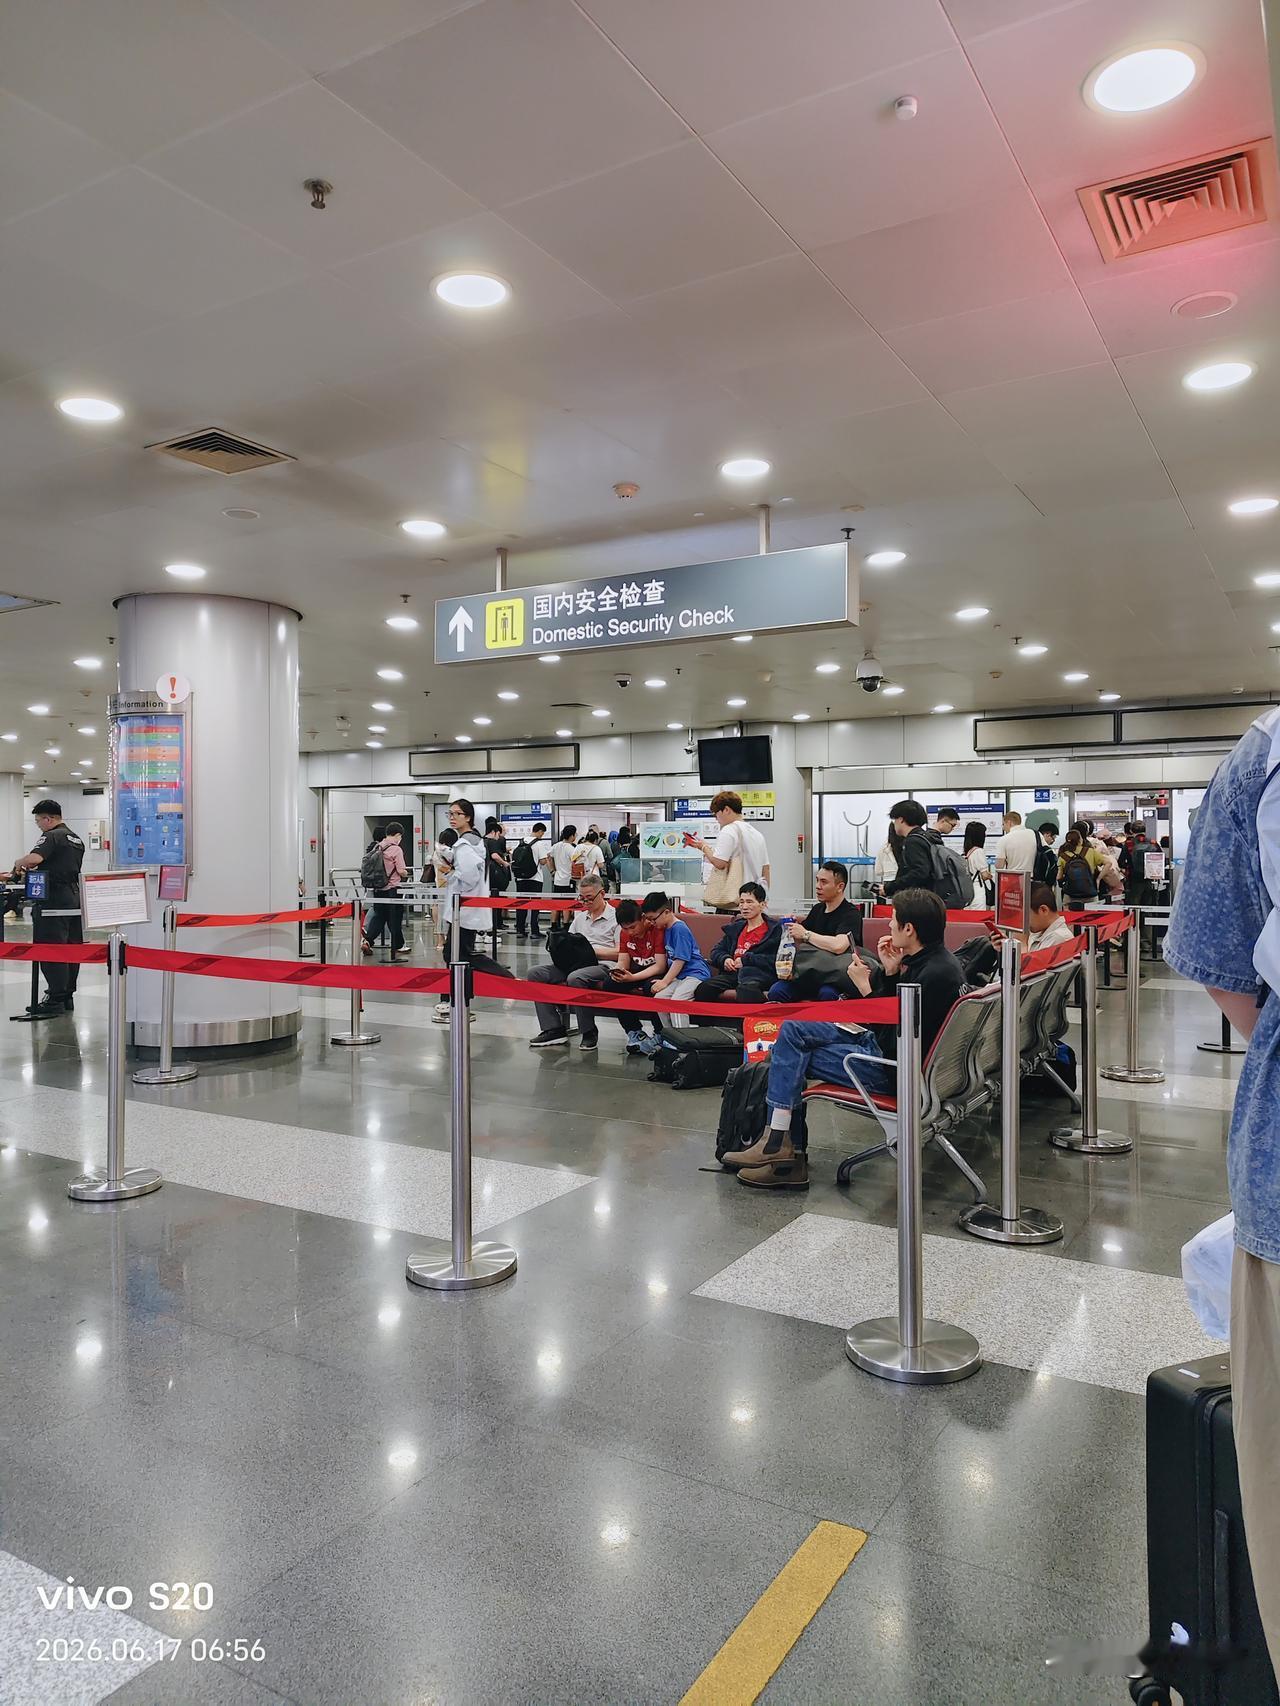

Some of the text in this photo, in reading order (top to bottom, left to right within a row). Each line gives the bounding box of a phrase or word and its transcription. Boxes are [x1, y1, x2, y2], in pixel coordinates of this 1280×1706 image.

[532, 579, 666, 621] 国内安全检查
[532, 605, 735, 645] Domestic Security Check
[118, 699, 164, 709] Information
[1051, 791, 1062, 800] 21
[689, 801, 698, 809] 20
